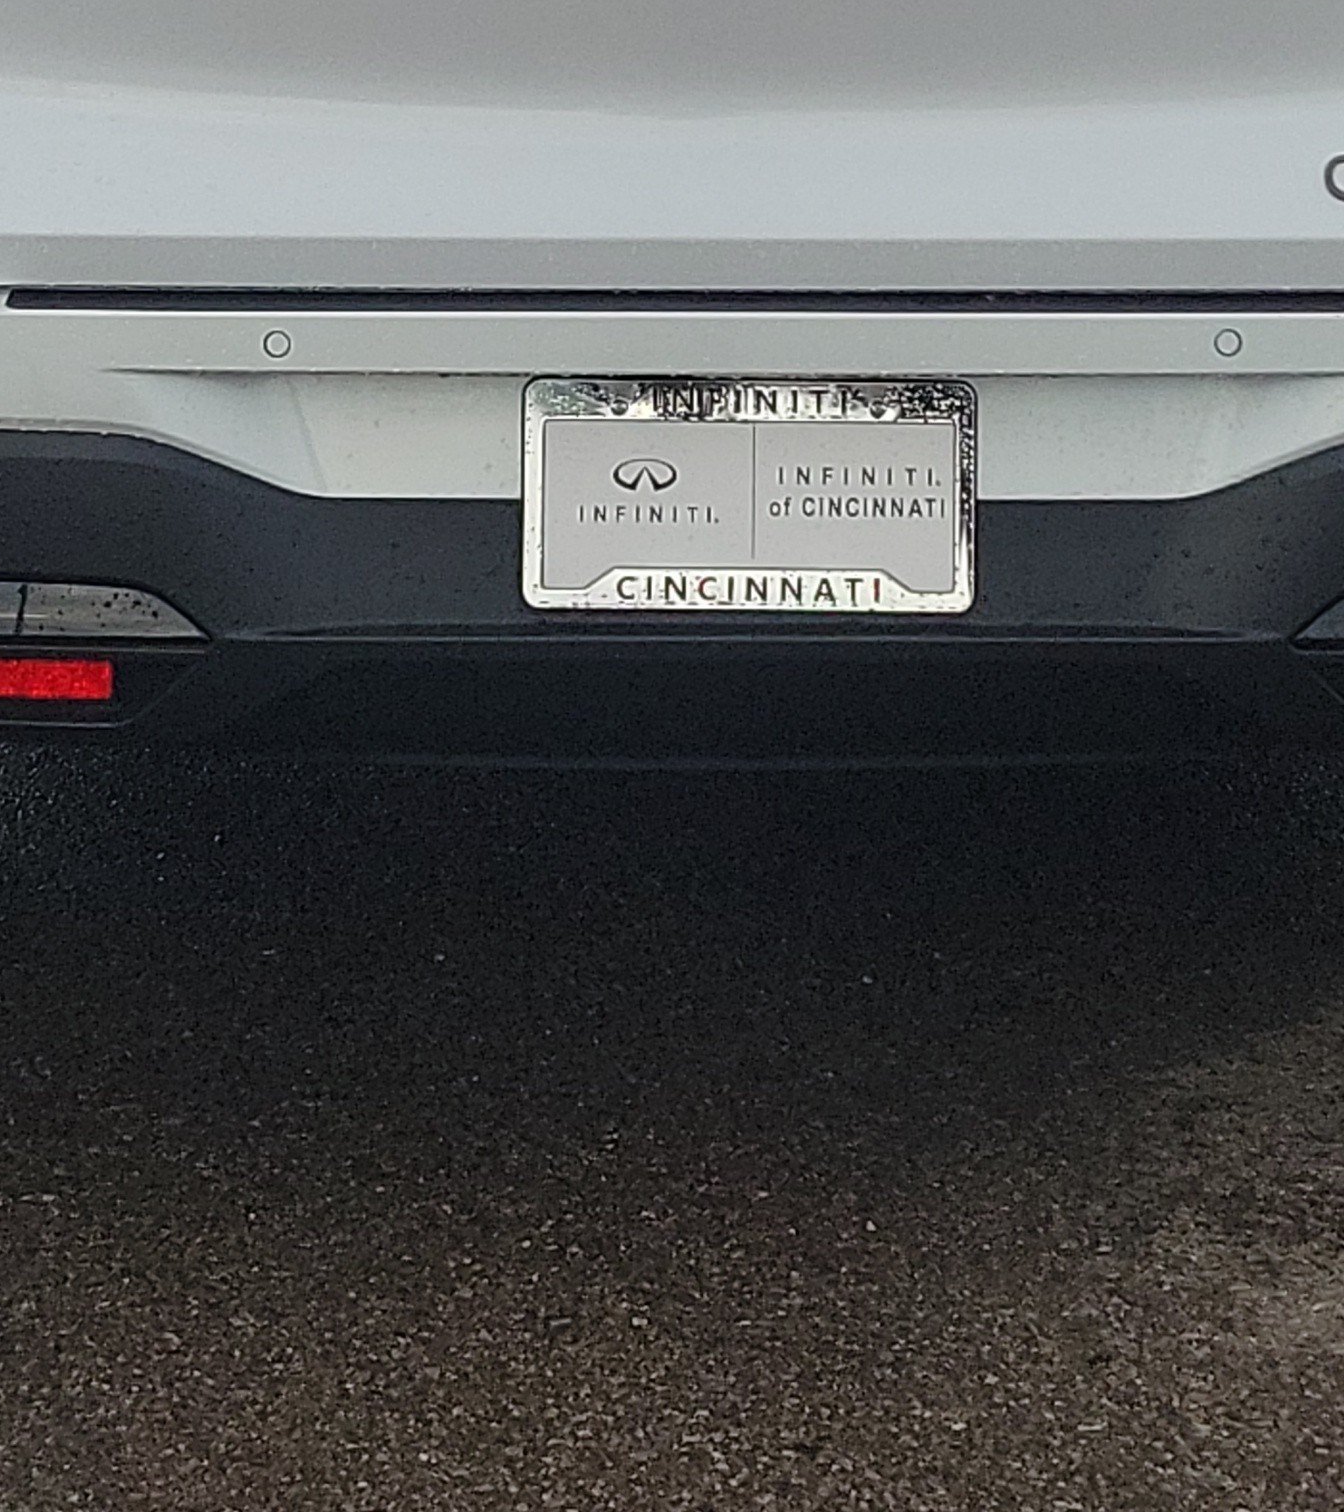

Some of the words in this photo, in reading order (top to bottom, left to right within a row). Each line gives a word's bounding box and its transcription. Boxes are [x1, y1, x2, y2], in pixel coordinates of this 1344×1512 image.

[652, 387, 848, 417] INFINITI
[769, 496, 792, 517] of
[801, 496, 945, 518] CINCINNATI
[616, 575, 881, 604] CINCINNATI
